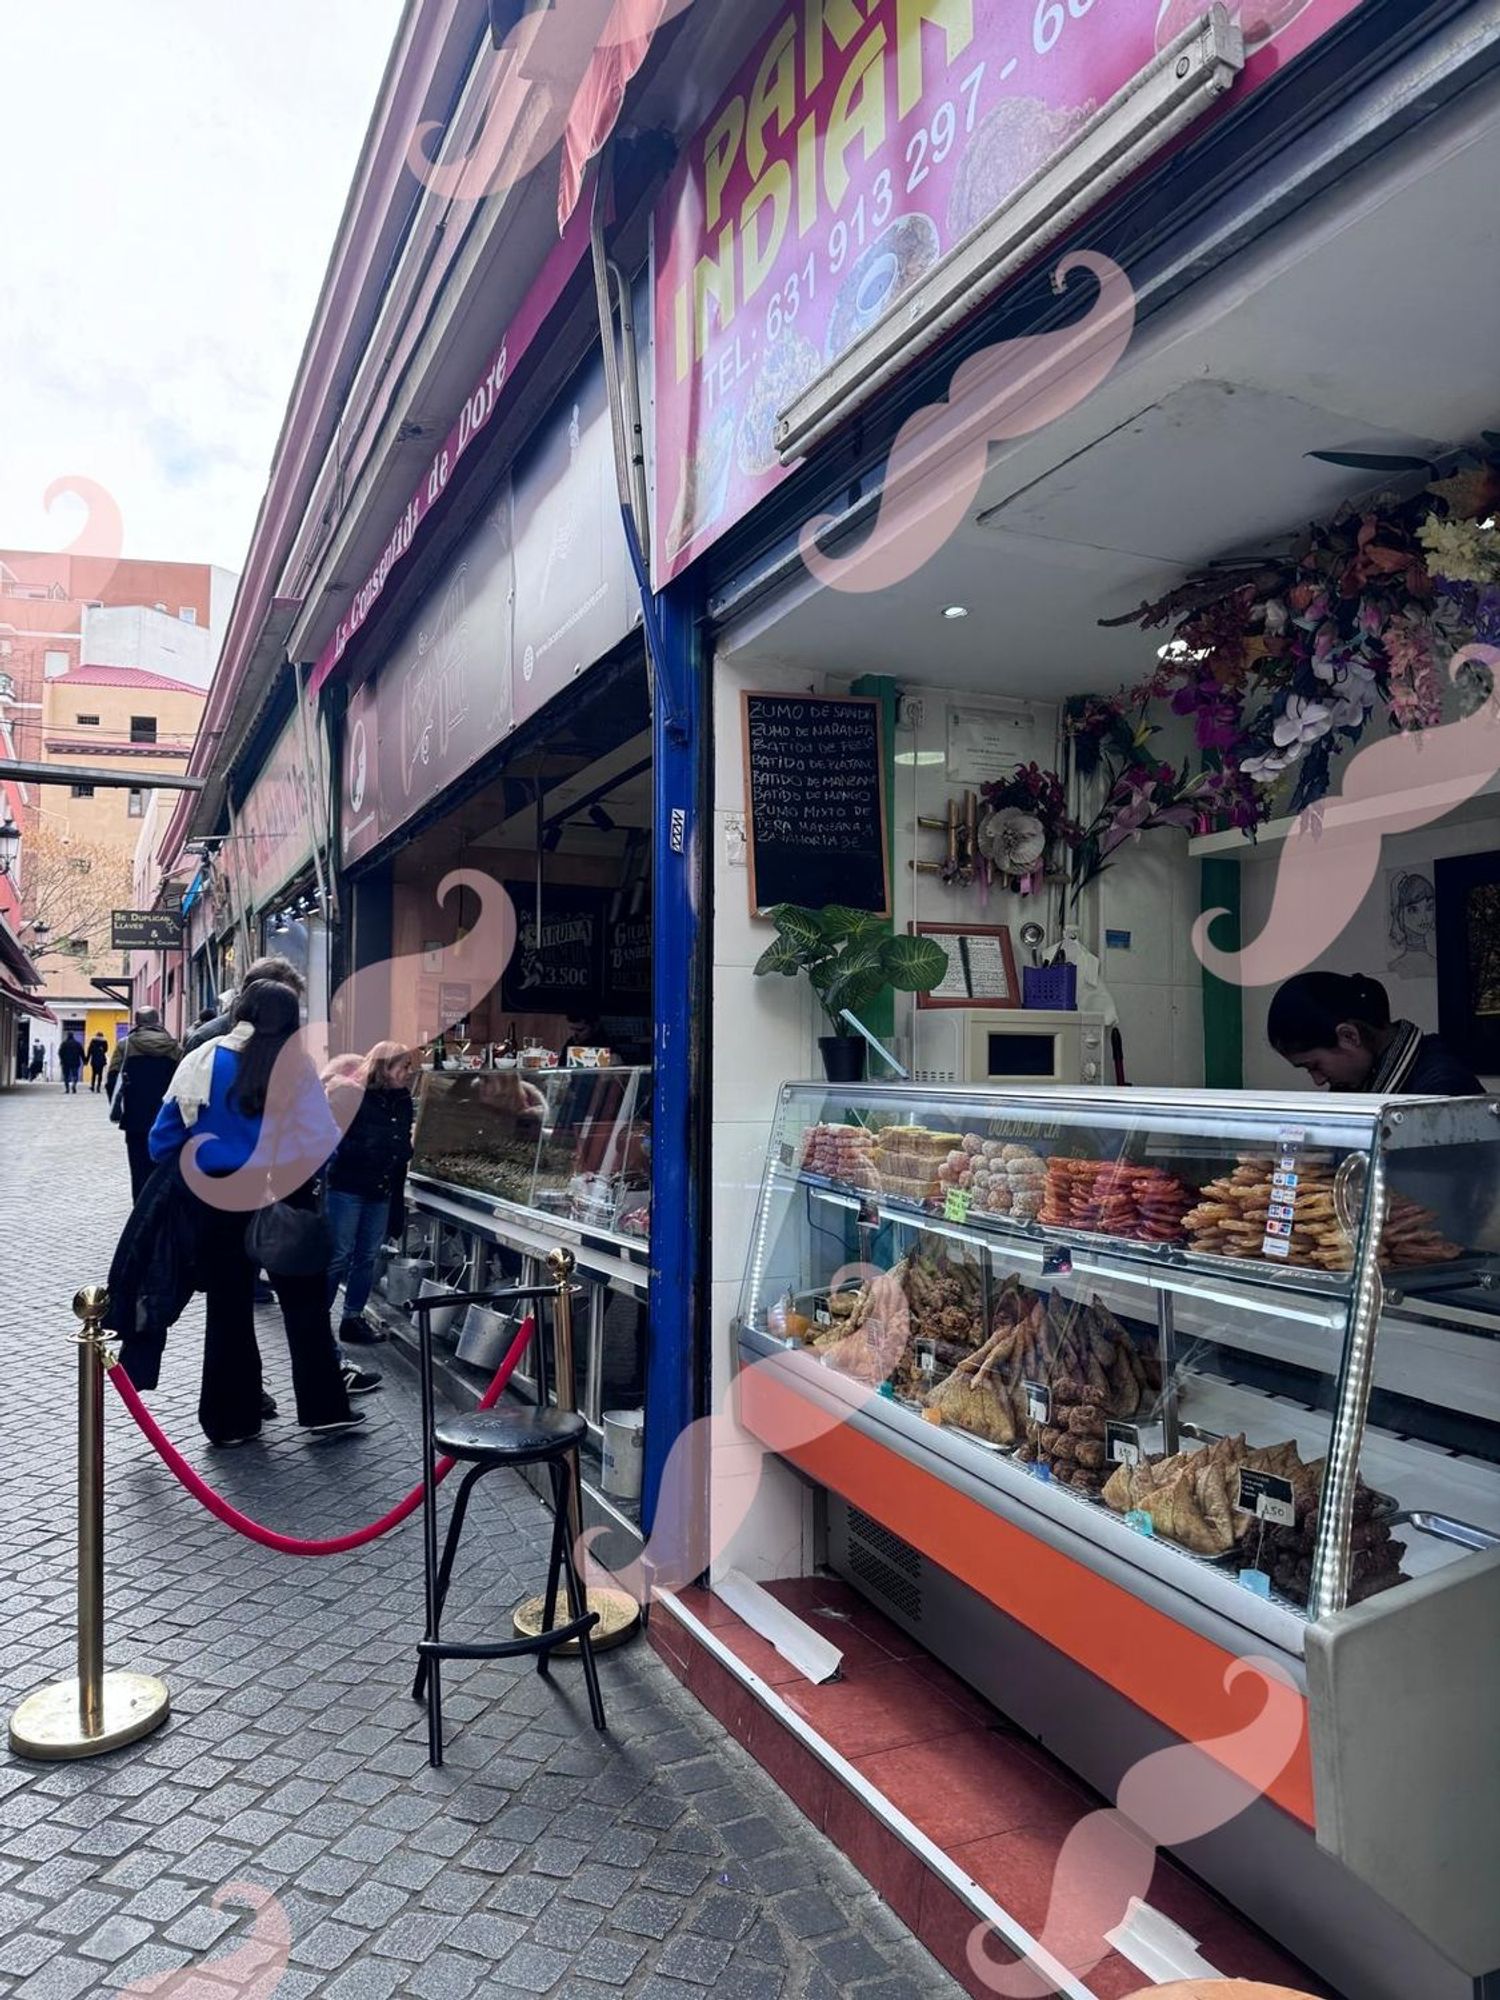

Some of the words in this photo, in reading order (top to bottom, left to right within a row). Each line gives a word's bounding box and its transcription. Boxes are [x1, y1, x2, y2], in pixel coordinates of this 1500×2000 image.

[703, 336, 757, 410] TEL:
[765, 252, 817, 342] 631
[828, 168, 893, 274] 913
[905, 61, 986, 194] 297
[427, 448, 449, 503] de
[749, 701, 805, 719] ZUMO
[810, 705, 833, 718] DE
[751, 722, 791, 737] ZUMO
[795, 726, 809, 736] DE
[752, 754, 806, 770] BATIDO
[753, 770, 803, 787] BATIDO
[806, 775, 820, 788] DE
[754, 786, 802, 802] BATIDO
[754, 803, 799, 817] ZUMO
[803, 805, 846, 818] MIXTO
[853, 805, 872, 816] DE
[150, 929, 159, 939] &
